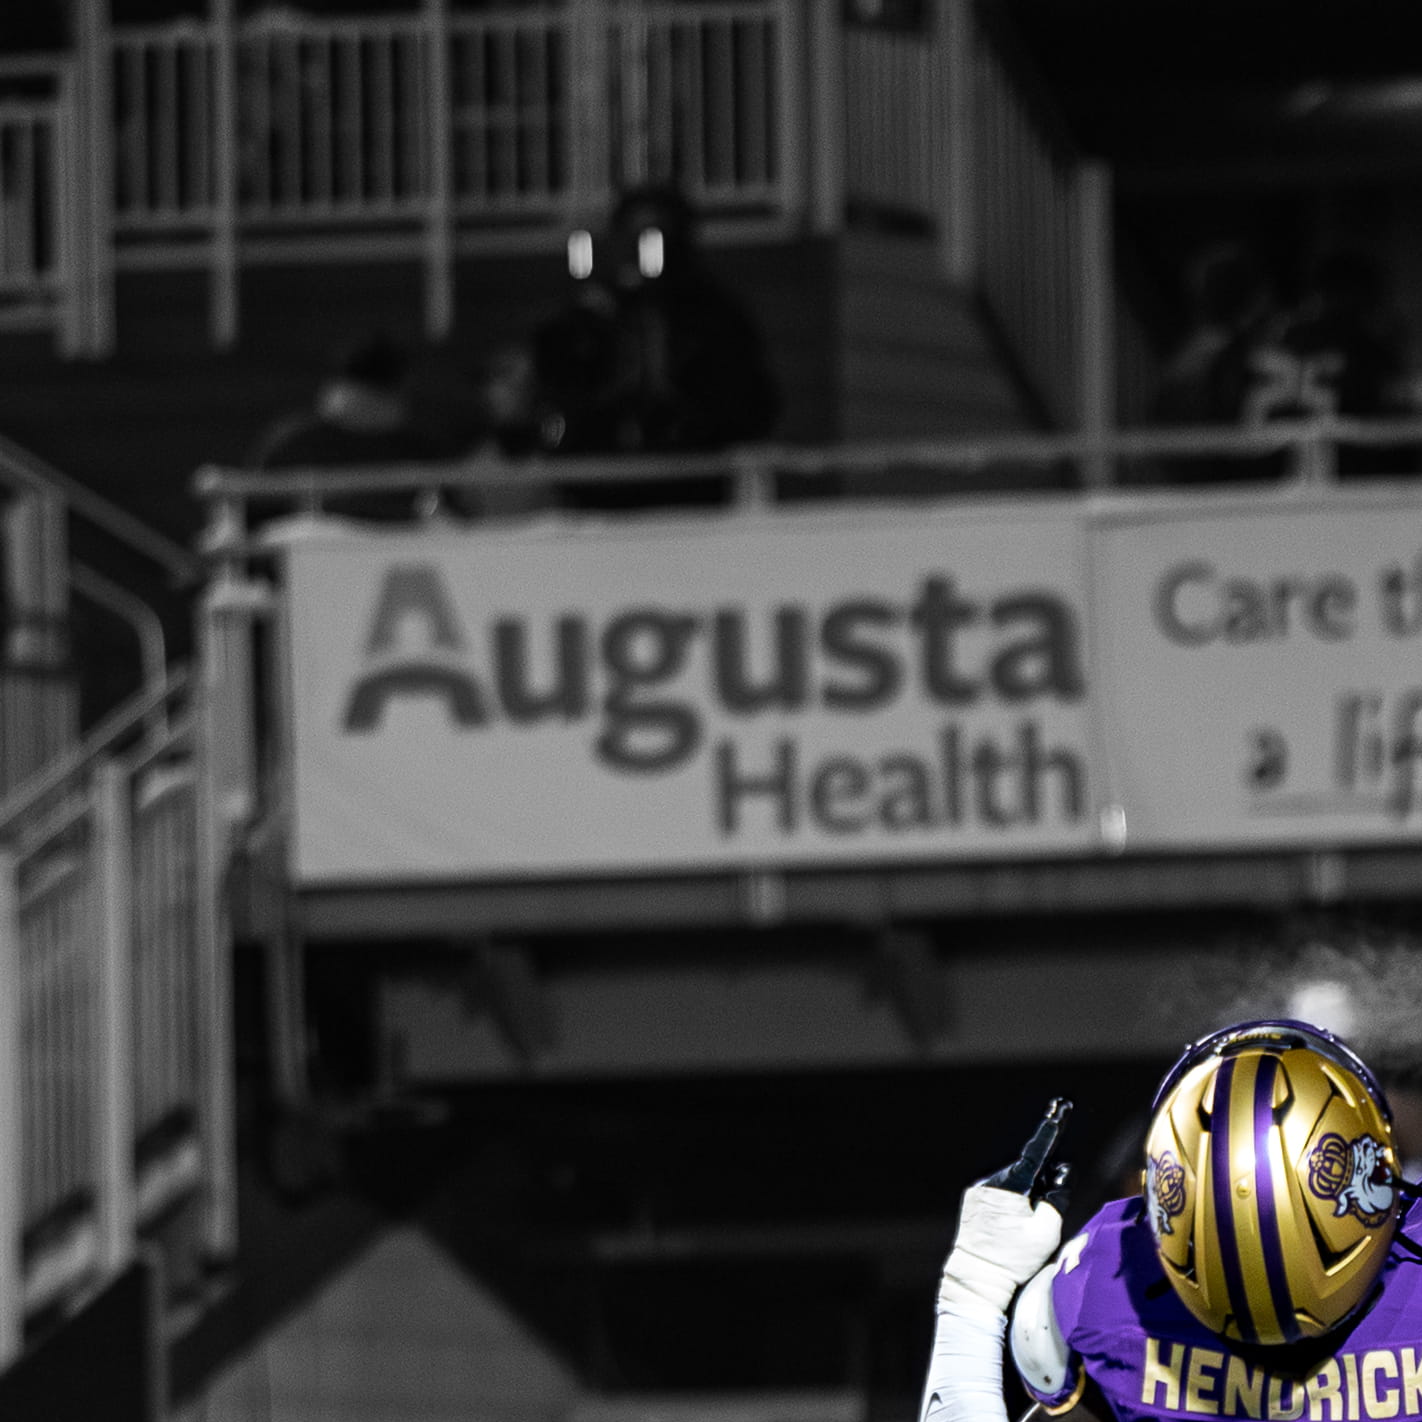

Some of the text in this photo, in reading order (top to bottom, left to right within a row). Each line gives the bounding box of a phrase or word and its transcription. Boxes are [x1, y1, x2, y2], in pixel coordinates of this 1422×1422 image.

[1153, 557, 1358, 648] Care
[341, 562, 1086, 775] Augusta
[713, 718, 1088, 840] Health
[1242, 726, 1291, 793] a
